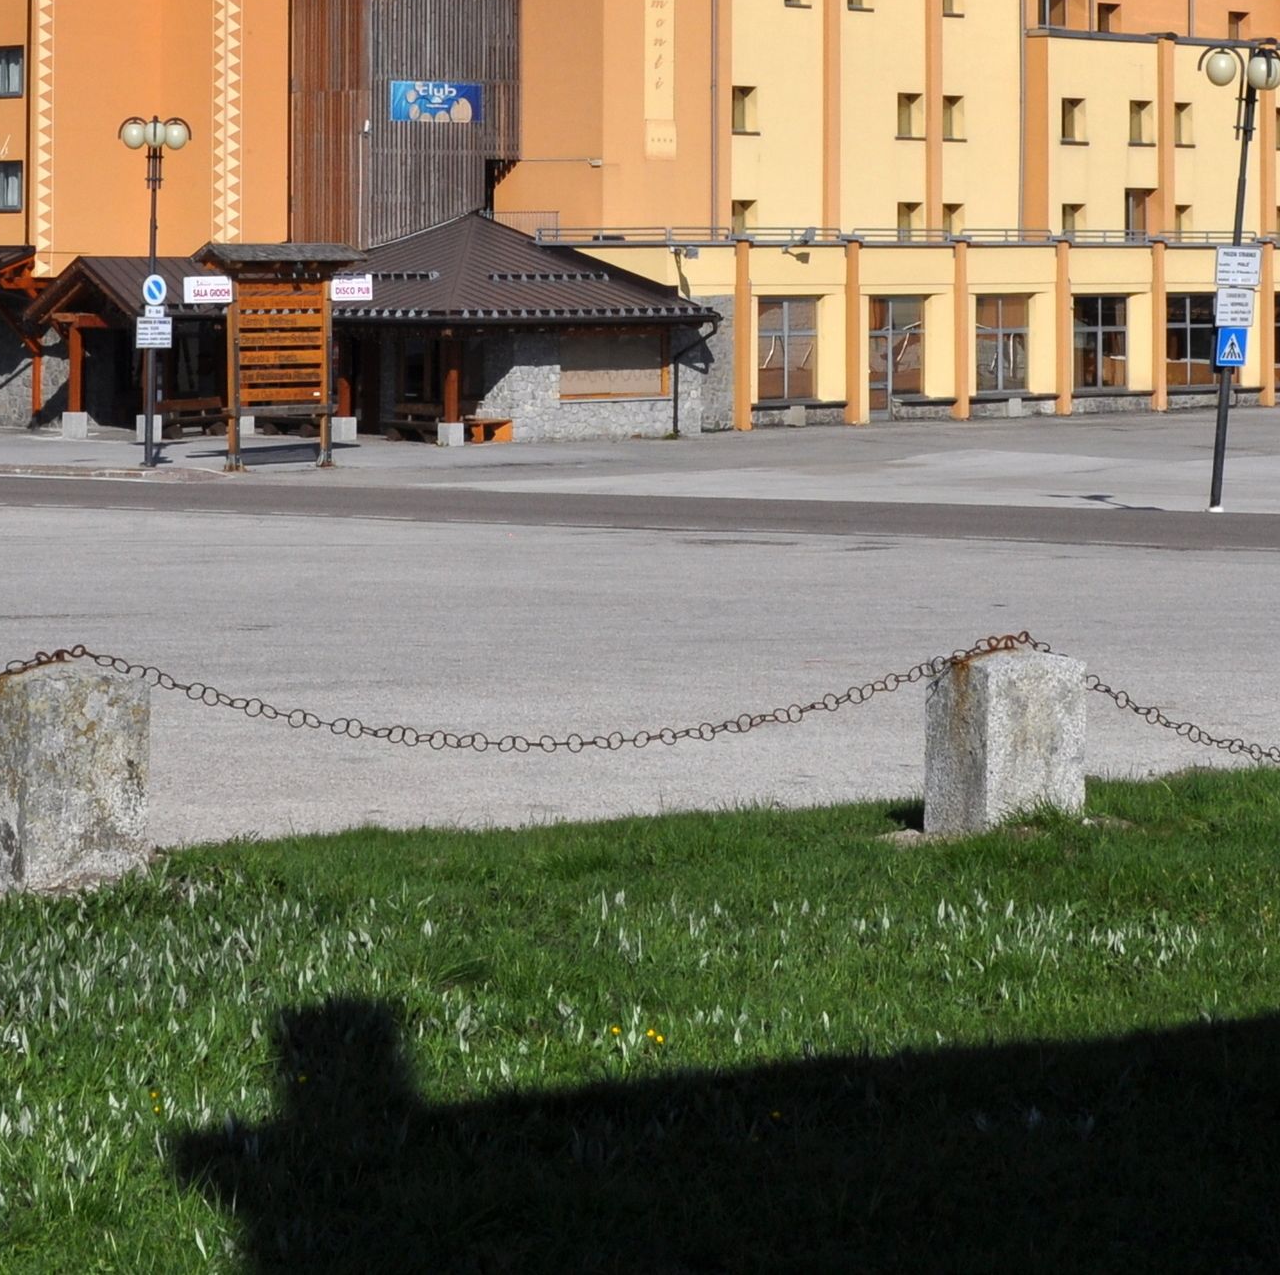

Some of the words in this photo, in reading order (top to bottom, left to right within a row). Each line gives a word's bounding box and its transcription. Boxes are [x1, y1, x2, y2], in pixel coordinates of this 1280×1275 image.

[193, 289, 208, 298] SALA
[210, 288, 231, 297] GIOCHI
[335, 287, 355, 295] DISCO
[358, 287, 370, 295] PUB
